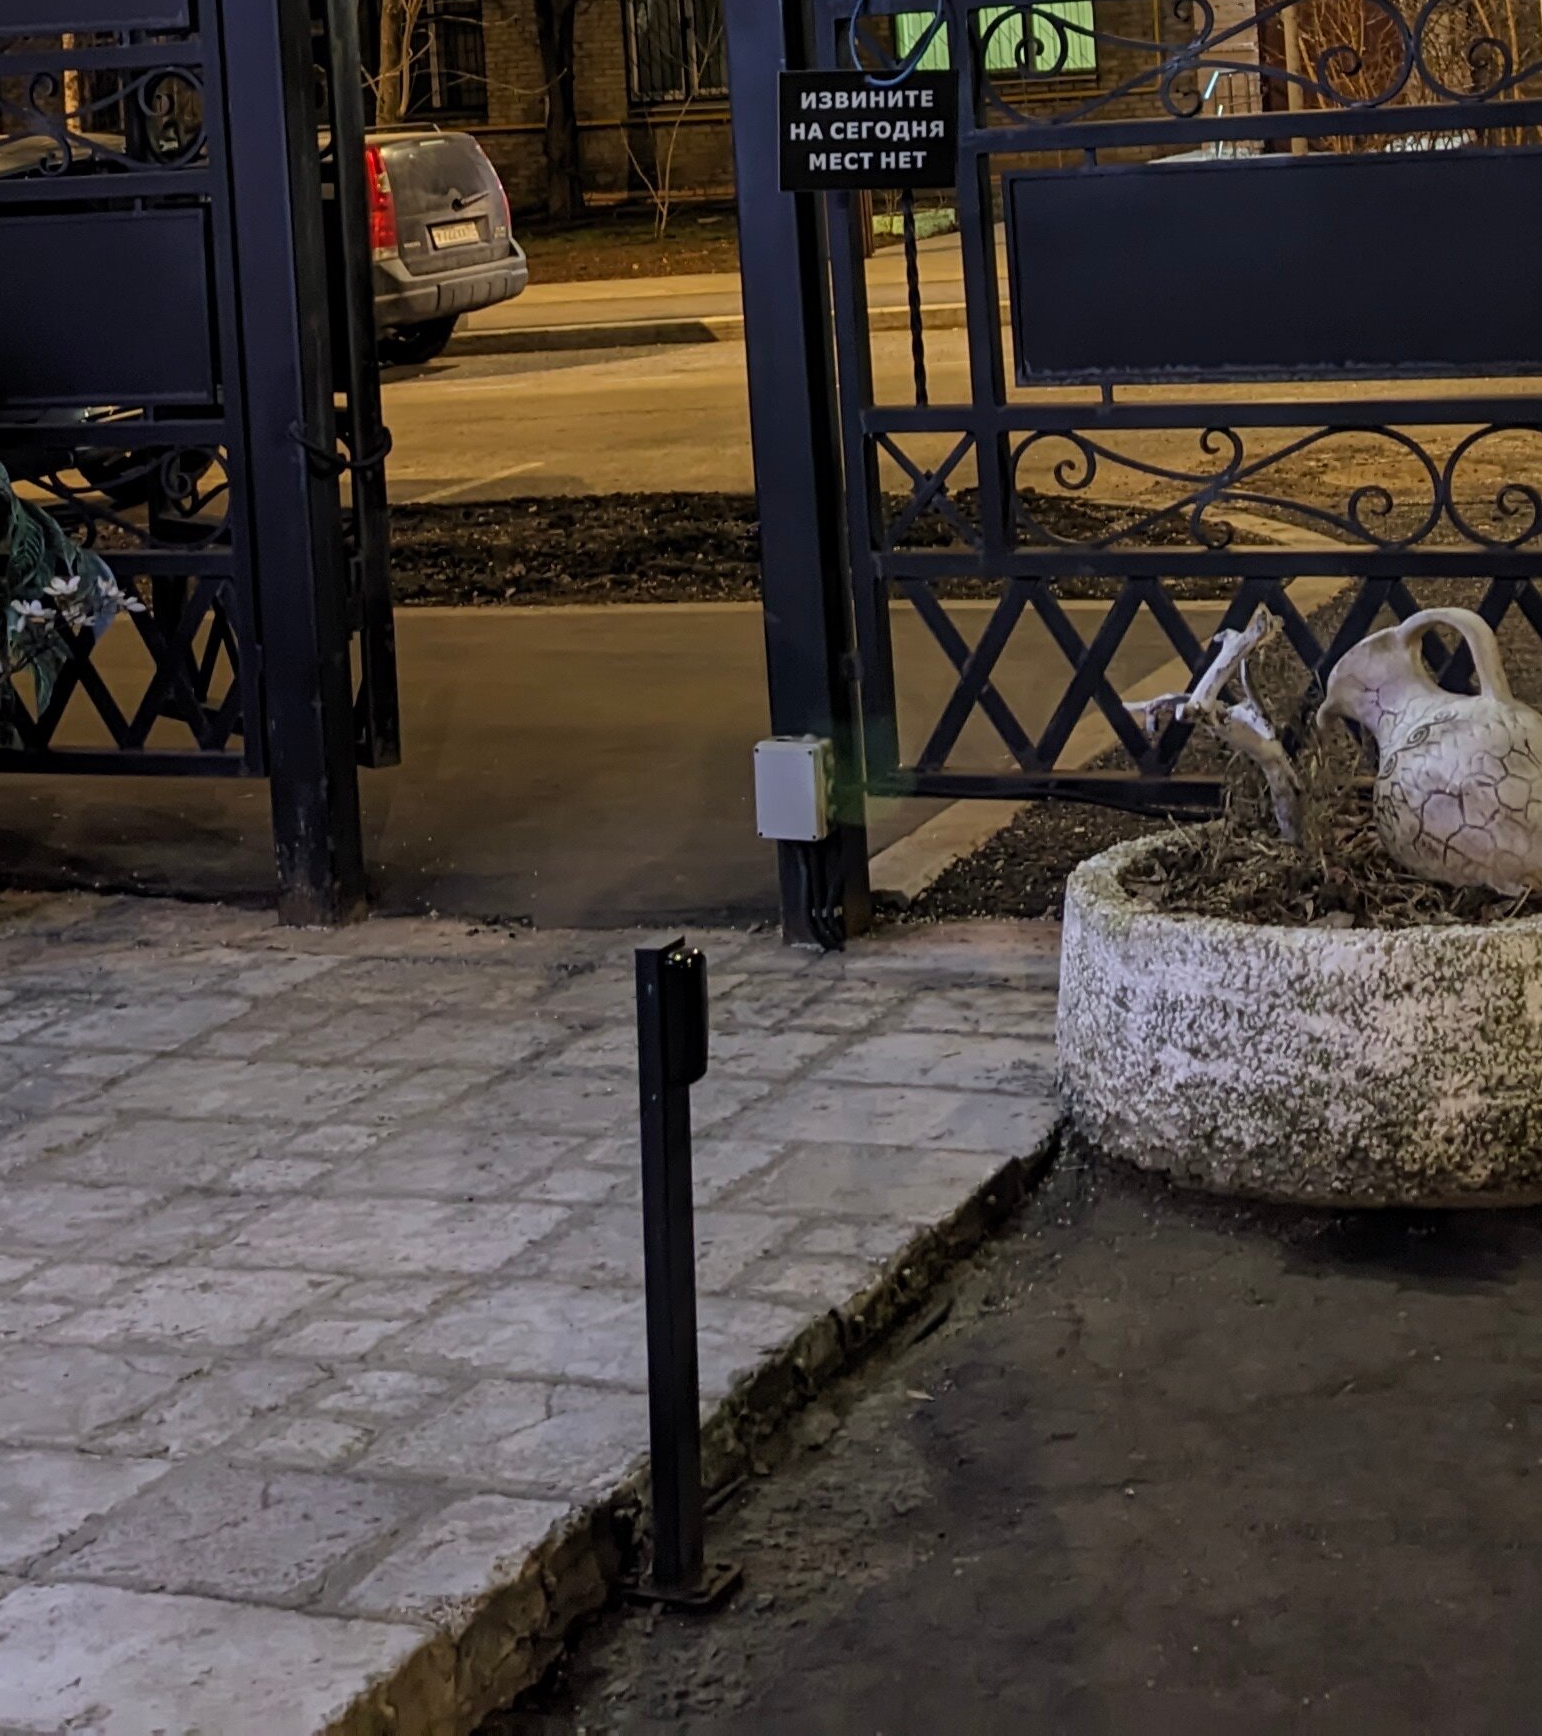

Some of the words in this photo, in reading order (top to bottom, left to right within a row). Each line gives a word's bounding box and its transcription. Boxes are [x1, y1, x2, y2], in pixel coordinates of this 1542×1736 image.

[800, 89, 934, 110] ИЗВИНИТЕ
[789, 122, 824, 141] НА
[829, 120, 945, 142] СЕГОДНЯ
[809, 151, 874, 171] МЕСТ
[880, 150, 927, 169] НЕТ
